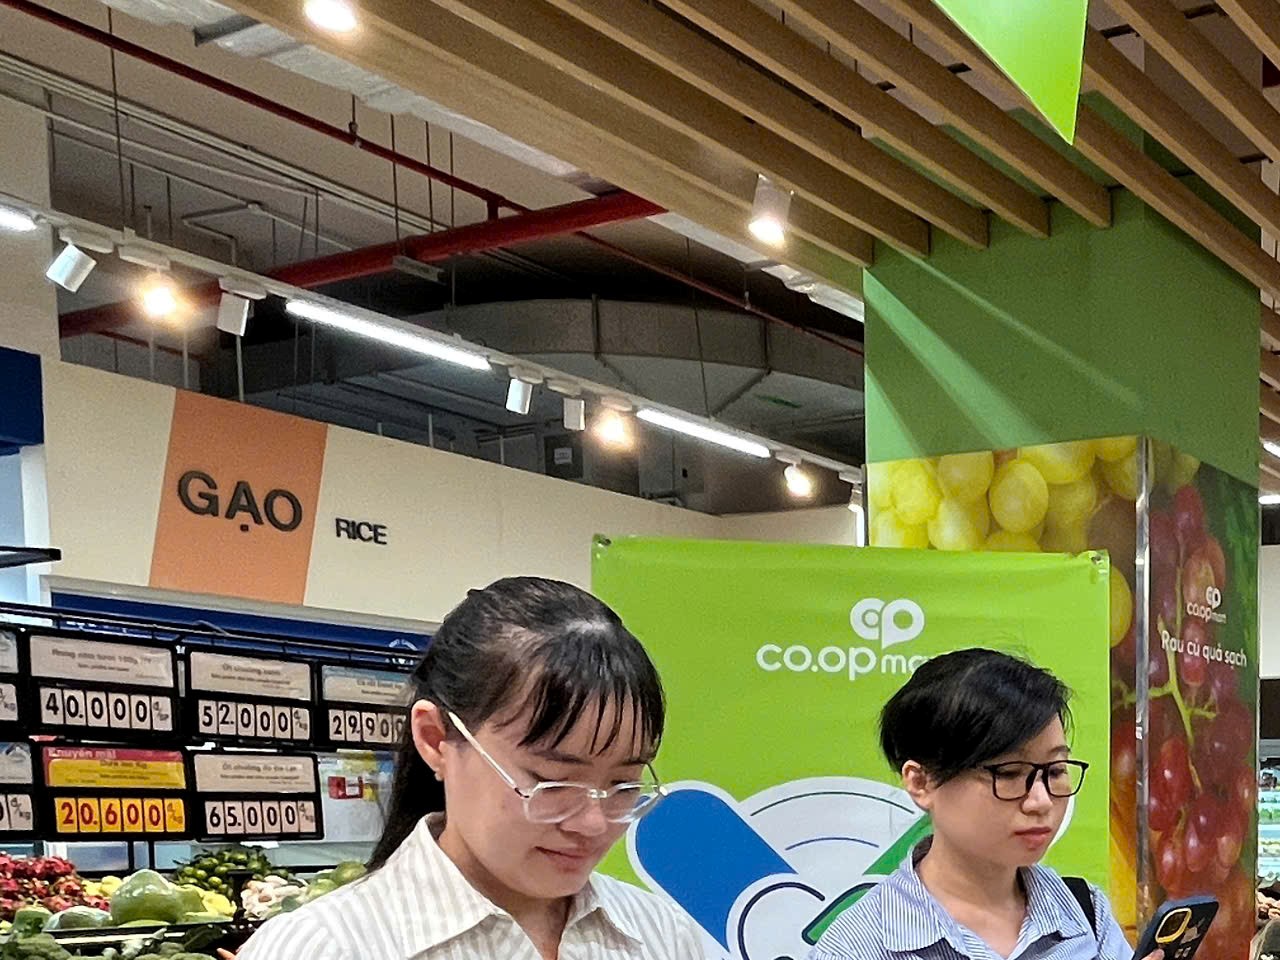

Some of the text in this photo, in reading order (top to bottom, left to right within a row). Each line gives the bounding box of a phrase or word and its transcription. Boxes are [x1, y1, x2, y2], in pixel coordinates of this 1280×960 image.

[177, 470, 304, 532] GẠO
[335, 518, 388, 545] RICE
[1161, 629, 1184, 653] Rau
[1202, 642, 1223, 664] quả
[1224, 647, 1247, 670] sạch
[46, 692, 148, 723] 40.000
[202, 703, 289, 737] 52.000
[61, 802, 161, 827] 20.600
[209, 805, 296, 828] 65.000
